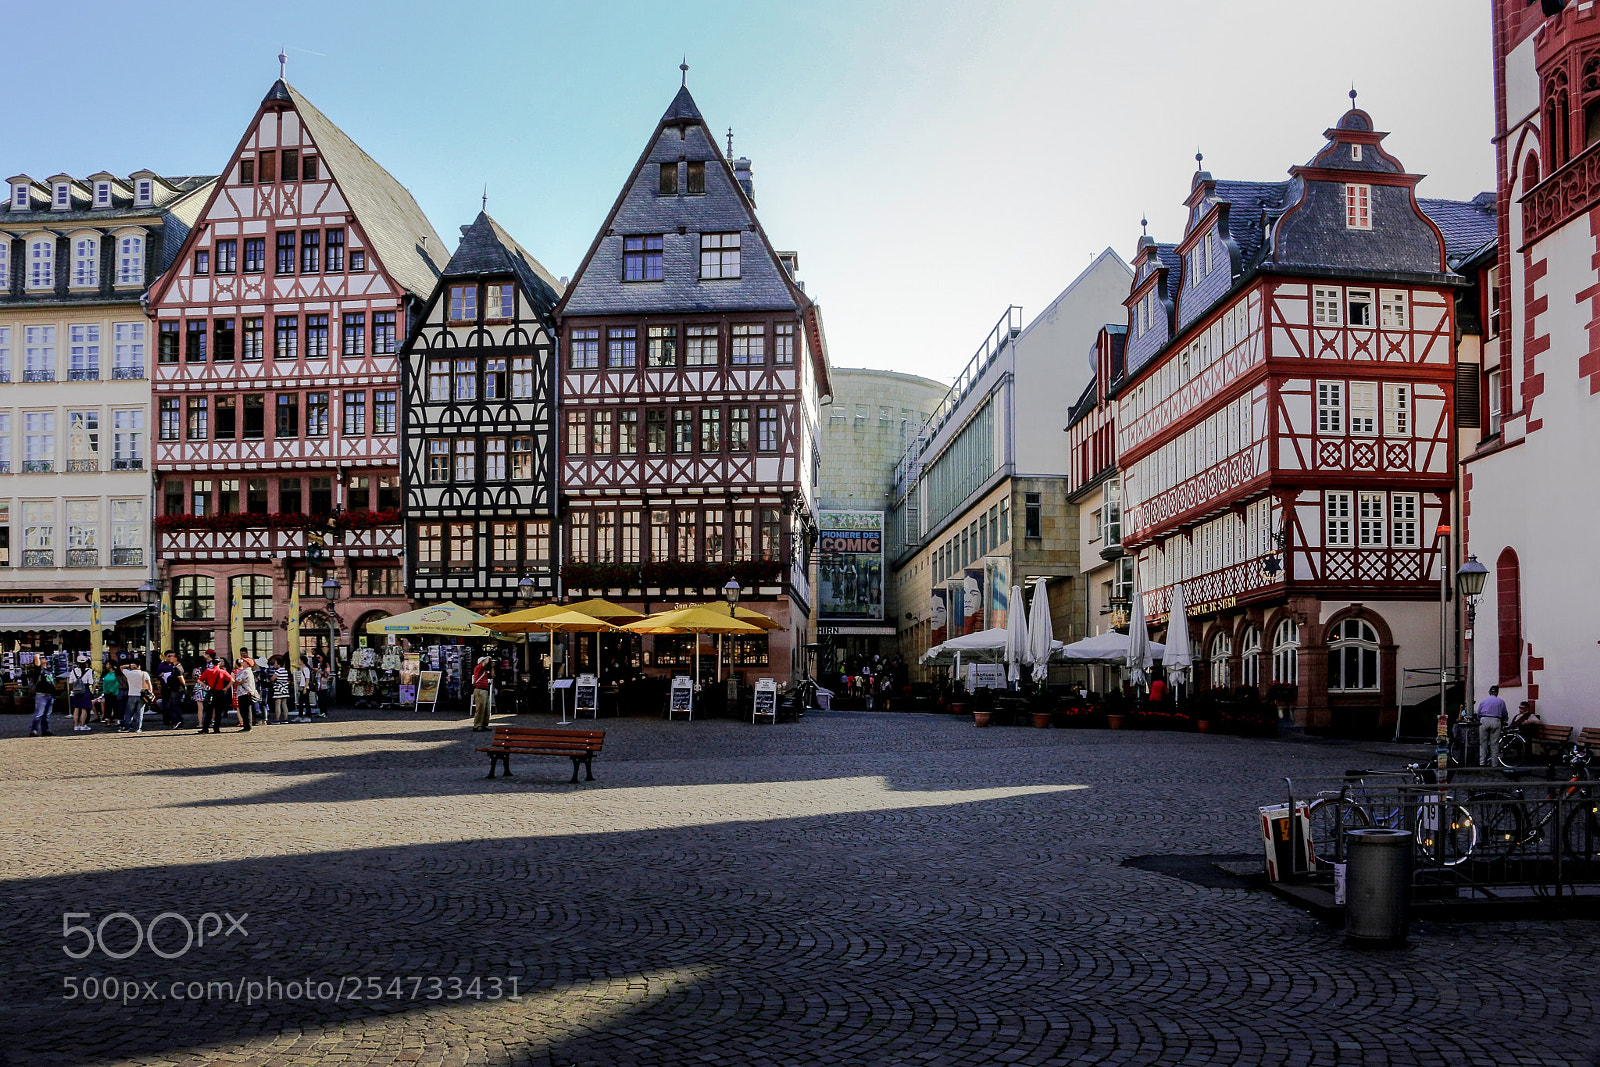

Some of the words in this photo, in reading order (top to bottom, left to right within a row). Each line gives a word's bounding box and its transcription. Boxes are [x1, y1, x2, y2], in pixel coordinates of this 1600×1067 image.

[822, 531, 860, 539] PIONIERE
[862, 531, 880, 539] DES
[821, 538, 880, 552] COMIC
